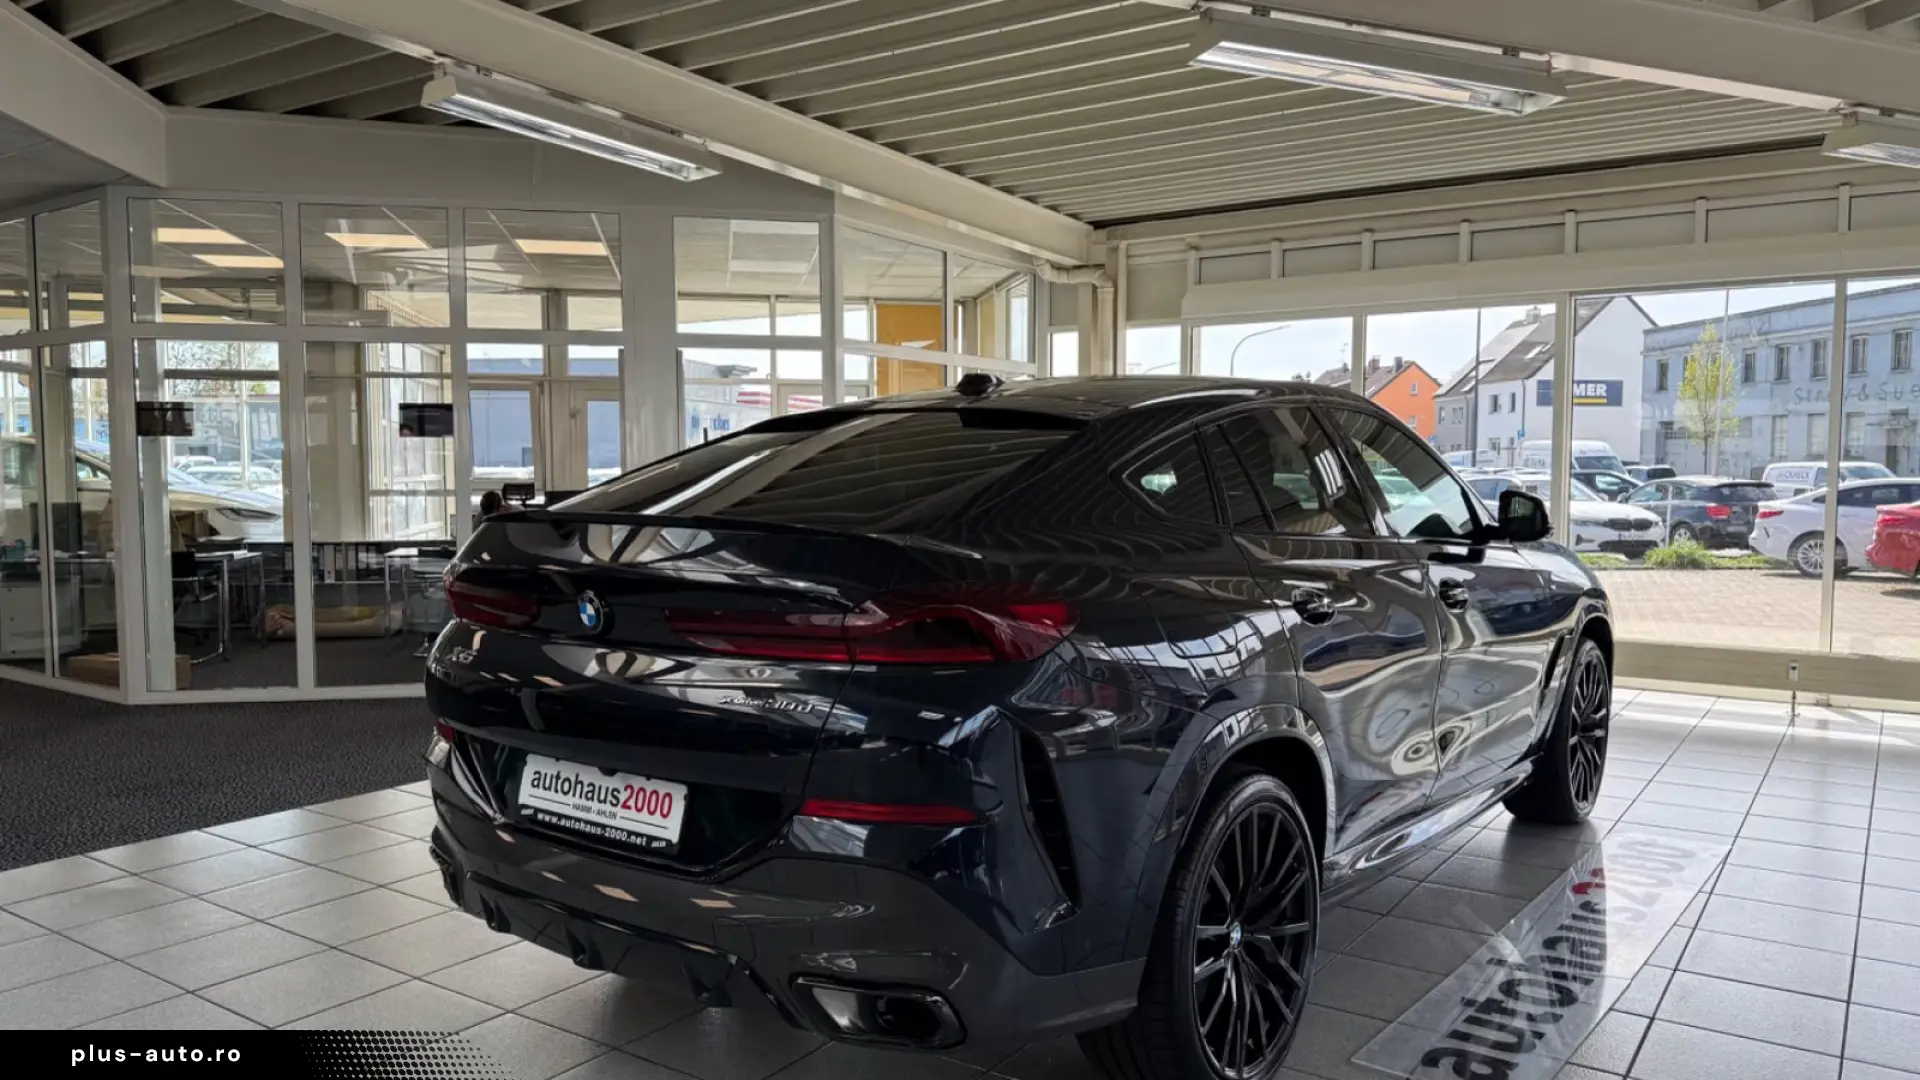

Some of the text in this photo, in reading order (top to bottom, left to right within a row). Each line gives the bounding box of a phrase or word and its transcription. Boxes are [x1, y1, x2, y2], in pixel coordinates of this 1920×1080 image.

[531, 770, 673, 819] autohaus2000
[537, 811, 647, 847] www.autohaus-2000.net
[595, 808, 618, 821] AHLEN
